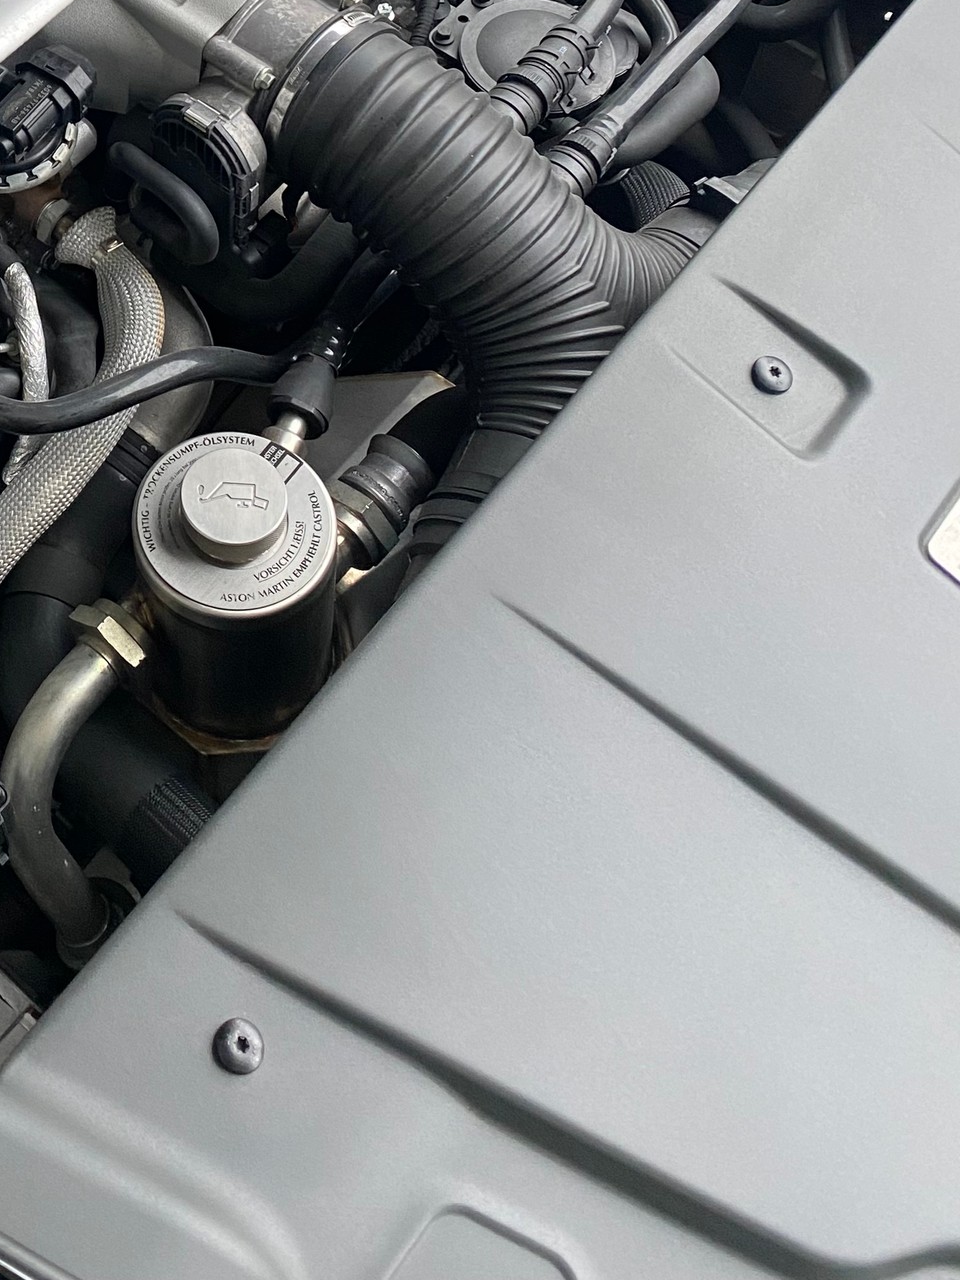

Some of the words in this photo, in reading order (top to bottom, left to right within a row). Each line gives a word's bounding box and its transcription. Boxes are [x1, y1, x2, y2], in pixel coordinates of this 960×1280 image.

[141, 510, 156, 553] WICHTIG
[220, 592, 255, 602] ASTON
[258, 576, 295, 598] MARTIN
[308, 490, 322, 532] CASTROL
[253, 549, 295, 581] VORSICHT
